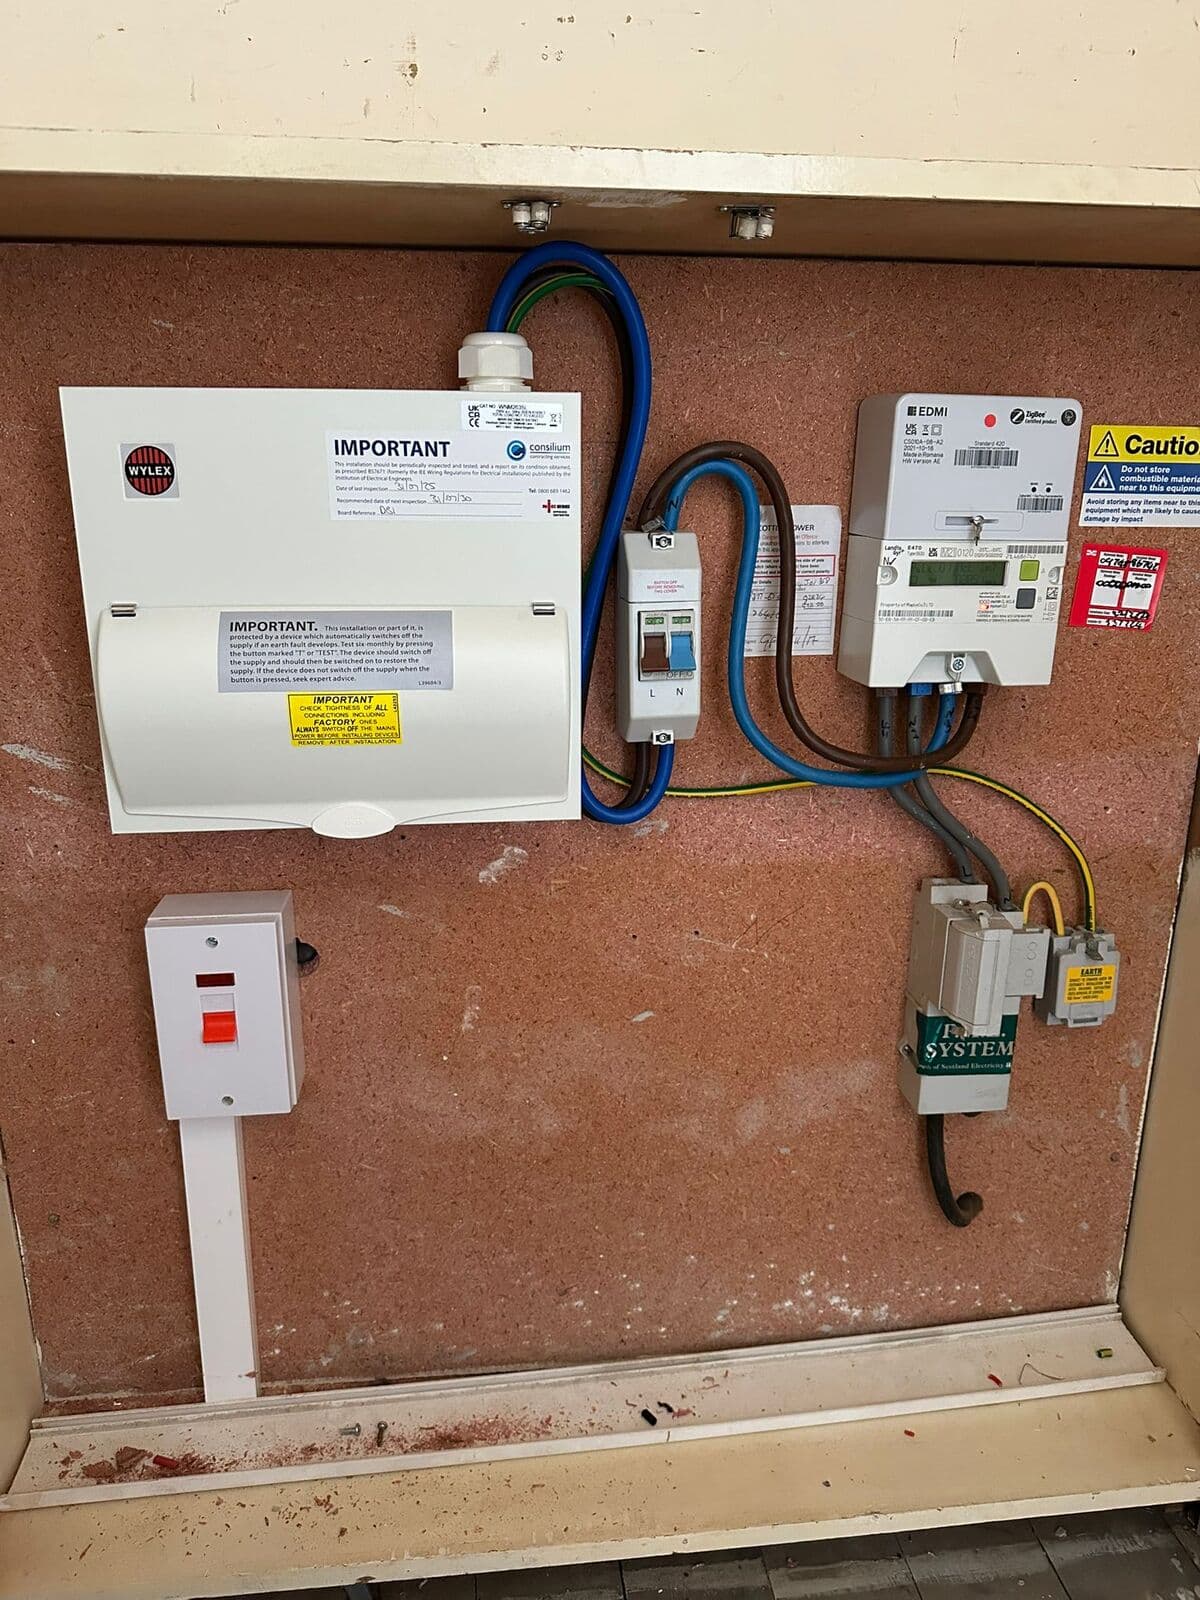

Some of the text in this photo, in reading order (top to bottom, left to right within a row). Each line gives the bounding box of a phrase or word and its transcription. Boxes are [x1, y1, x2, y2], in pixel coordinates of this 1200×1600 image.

[919, 406, 948, 417] EDMI
[1025, 410, 1046, 419] ZigBee
[334, 439, 451, 457] IMPORTANT
[529, 442, 571, 451] consilium
[1125, 434, 1200, 455] Cautio
[128, 466, 172, 476] WYLEX
[1121, 465, 1133, 473] Do
[1106, 498, 1129, 506] storing
[1154, 507, 1172, 516] likely
[230, 621, 318, 632] IMPORTANT.
[405, 640, 434, 648] pressing
[376, 666, 398, 674] supply
[418, 664, 430, 672] the
[262, 676, 292, 684] pressed,
[650, 688, 684, 698] L N
[313, 696, 374, 704] IMPORTANT
[314, 718, 356, 726] FACTORY
[1081, 968, 1103, 976] EARTH
[926, 1041, 1014, 1058] SYSTEM
[972, 1062, 1004, 1070] Electricity
